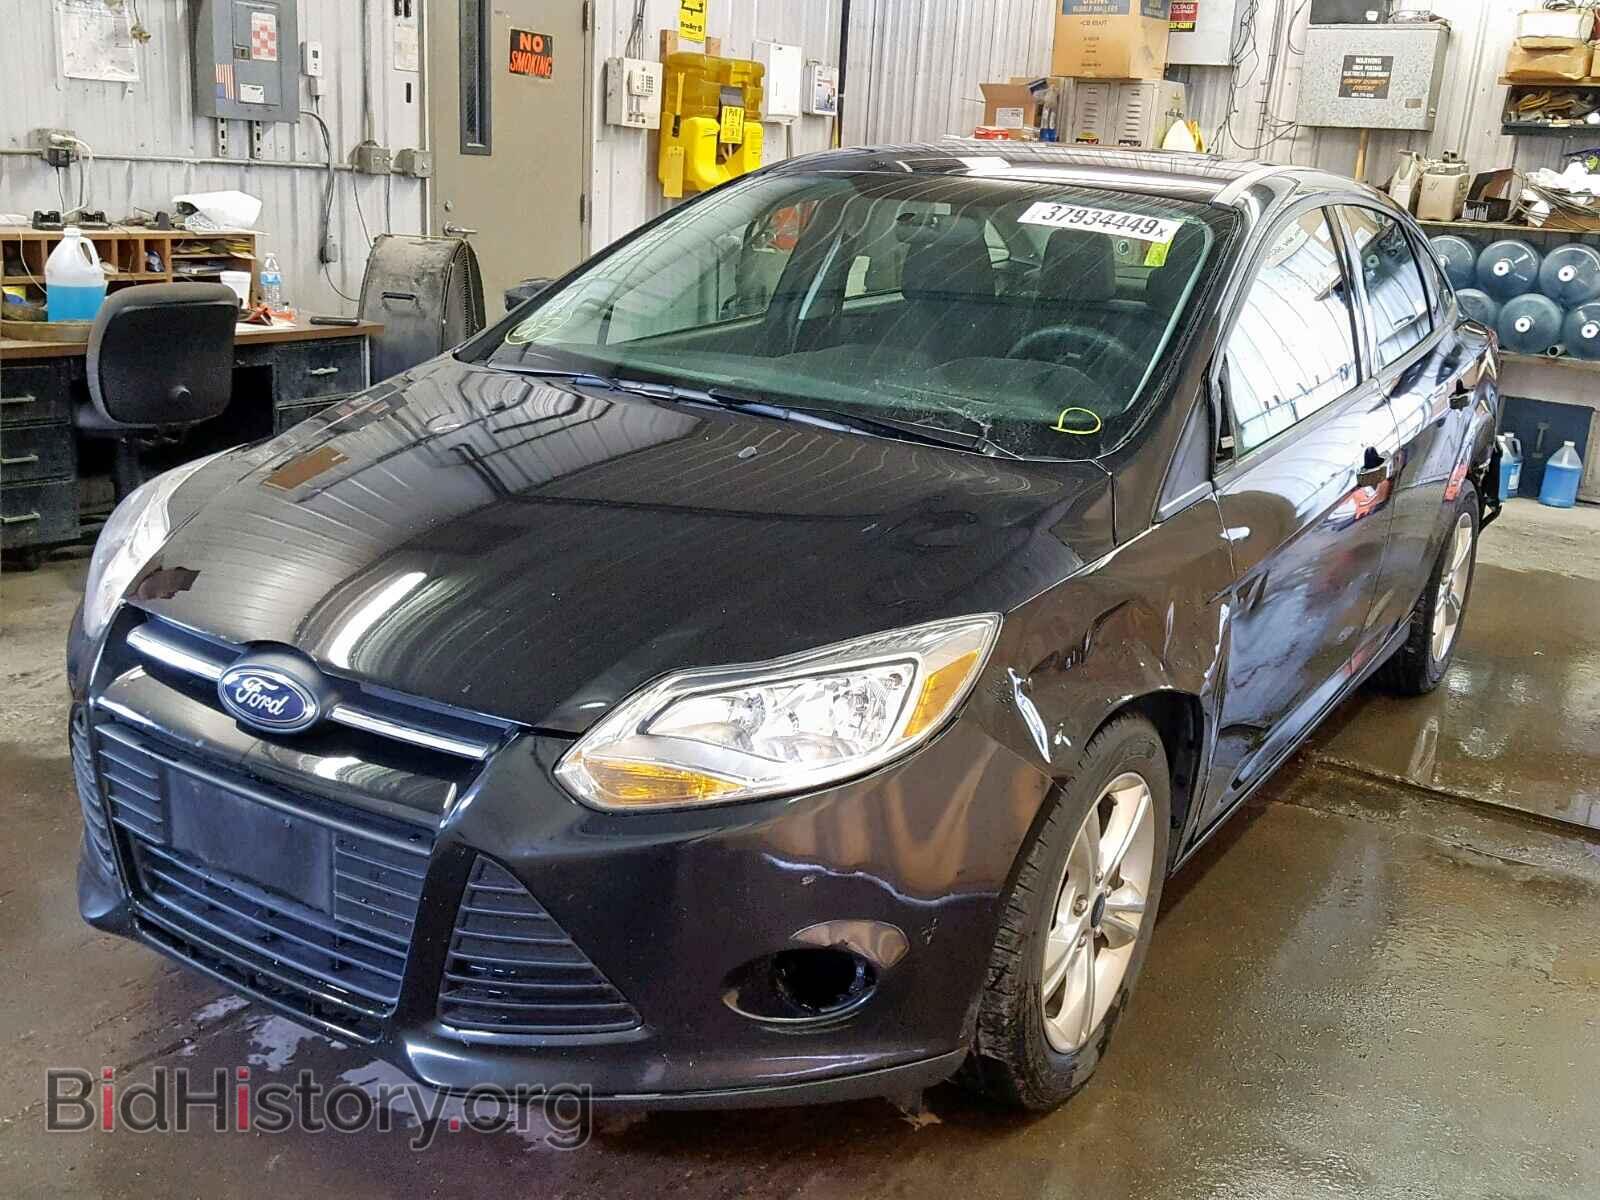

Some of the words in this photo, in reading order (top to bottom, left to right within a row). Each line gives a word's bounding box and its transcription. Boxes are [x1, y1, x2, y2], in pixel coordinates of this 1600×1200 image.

[519, 31, 544, 53] NO
[510, 50, 553, 76] SMOKING
[1042, 205, 1158, 235] 37934449
[236, 677, 290, 716] Ford
